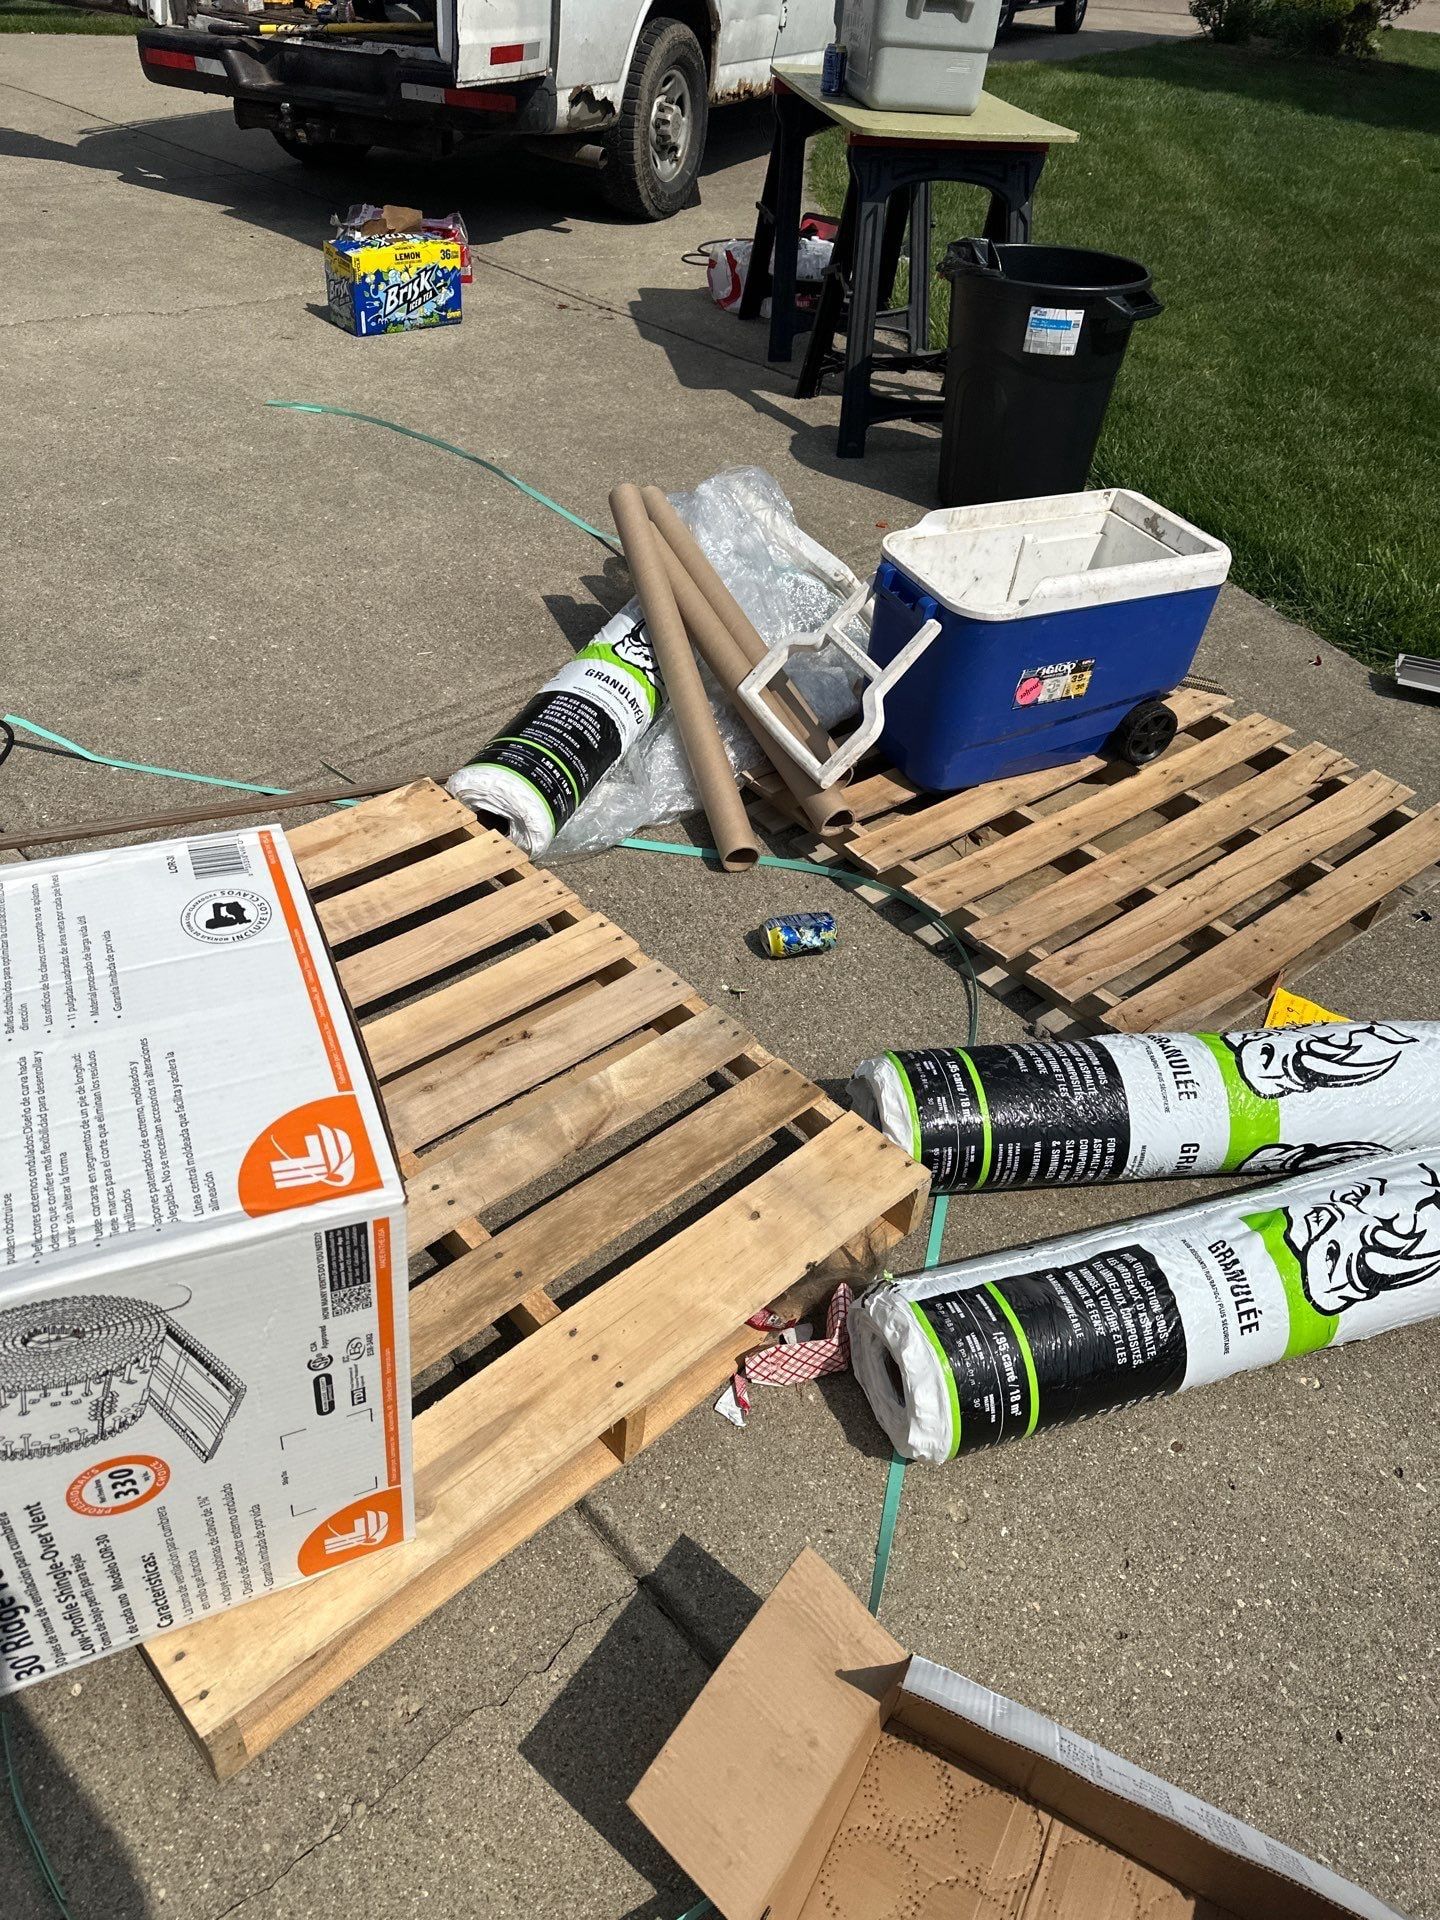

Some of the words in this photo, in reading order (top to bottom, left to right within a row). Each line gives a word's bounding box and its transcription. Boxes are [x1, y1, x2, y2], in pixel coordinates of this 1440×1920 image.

[394, 252, 421, 260] LEMON
[440, 250, 450, 260] 36
[580, 703, 598, 717] UNDER
[220, 891, 259, 902] CLAVOS
[259, 902, 268, 915] LOS
[231, 917, 268, 941] INCLUYE
[140, 1038, 154, 1078] alteraciones
[167, 1059, 179, 1083] acelera
[20, 1076, 29, 1096] curva
[76, 1086, 85, 1094] de
[91, 1080, 100, 1091] los
[129, 1067, 142, 1105] moldeados
[20, 1097, 30, 1106] de
[37, 1096, 49, 1112] para
[77, 1096, 89, 1107] pie
[148, 1087, 161, 1123] accesorios
[960, 1098, 970, 1107] 18
[81, 1109, 88, 1119] un
[178, 1113, 189, 1127] que
[80, 1120, 89, 1129] de
[98, 1124, 108, 1138] que
[82, 1130, 97, 1171] segmentos
[100, 1139, 109, 1159] corte
[139, 1139, 149, 1149] de
[154, 1124, 167, 1160] necesitan
[179, 1128, 195, 1165] moldeada
[1107, 1138, 1115, 1152] FOR
[1064, 1140, 1074, 1163] SLATE
[1090, 1139, 1102, 1169] ASPHALT
[58, 1152, 68, 1175] forma
[142, 1151, 157, 1193] patentados
[160, 1160, 169, 1169] se
[88, 1173, 96, 1183] en
[105, 1169, 116, 1186] para
[162, 1170, 171, 1182] No
[185, 1167, 200, 1193] central
[29, 1177, 40, 1213] externos
[44, 1172, 56, 1205] confiere
[62, 1185, 73, 1210] alterar
[90, 1185, 101, 1216] cortarse
[107, 1187, 117, 1216] marcas
[49, 1206, 59, 1222] que
[64, 1212, 74, 1223] sin
[314, 1232, 324, 1251] NEED?
[316, 1251, 325, 1263] YOU
[317, 1264, 325, 1272] DO
[318, 1273, 327, 1289] VENTS
[1207, 1240, 1263, 1336] GRANULÉE
[320, 1290, 328, 1306] MANY
[1133, 1262, 1161, 1313] UTILISATION
[1155, 1314, 1169, 1339] SOUS
[322, 1307, 330, 1319] HOW
[1218, 1304, 1226, 1318] PLUS
[318, 1325, 329, 1349] Approved
[1113, 1334, 1123, 1345] ET
[1116, 1347, 1127, 1365] LES
[1001, 1354, 1018, 1383] carré
[1010, 1389, 1021, 1402] 18
[974, 1398, 980, 1408] 30
[150, 1460, 167, 1486] CHOICE
[69, 1468, 112, 1514] PROFESSIONAL'S
[108, 1468, 140, 1499] 330
[23, 1502, 48, 1533] Vent
[95, 1534, 116, 1562] LOR-30
[205, 1537, 218, 1545] de
[14, 1551, 31, 1568] para
[36, 1533, 76, 1601] Shingle-Over
[70, 1554, 87, 1572] tejas
[80, 1572, 94, 1588] para
[103, 1563, 125, 1591] Modelo
[19, 1570, 43, 1607] ventilación
[83, 1589, 101, 1606] perfil
[117, 1594, 131, 1607] uno
[34, 1607, 47, 1617] de
[90, 1607, 104, 1622] bajo
[120, 1608, 134, 1624] cada
[41, 1617, 57, 1635] toma
[63, 1602, 96, 1658] Low-Profile
[94, 1623, 105, 1631] de
[125, 1625, 137, 1633] de
[97, 1632, 113, 1650] Toma
[50, 1644, 66, 1656] pies
[56, 1657, 68, 1667] 30
